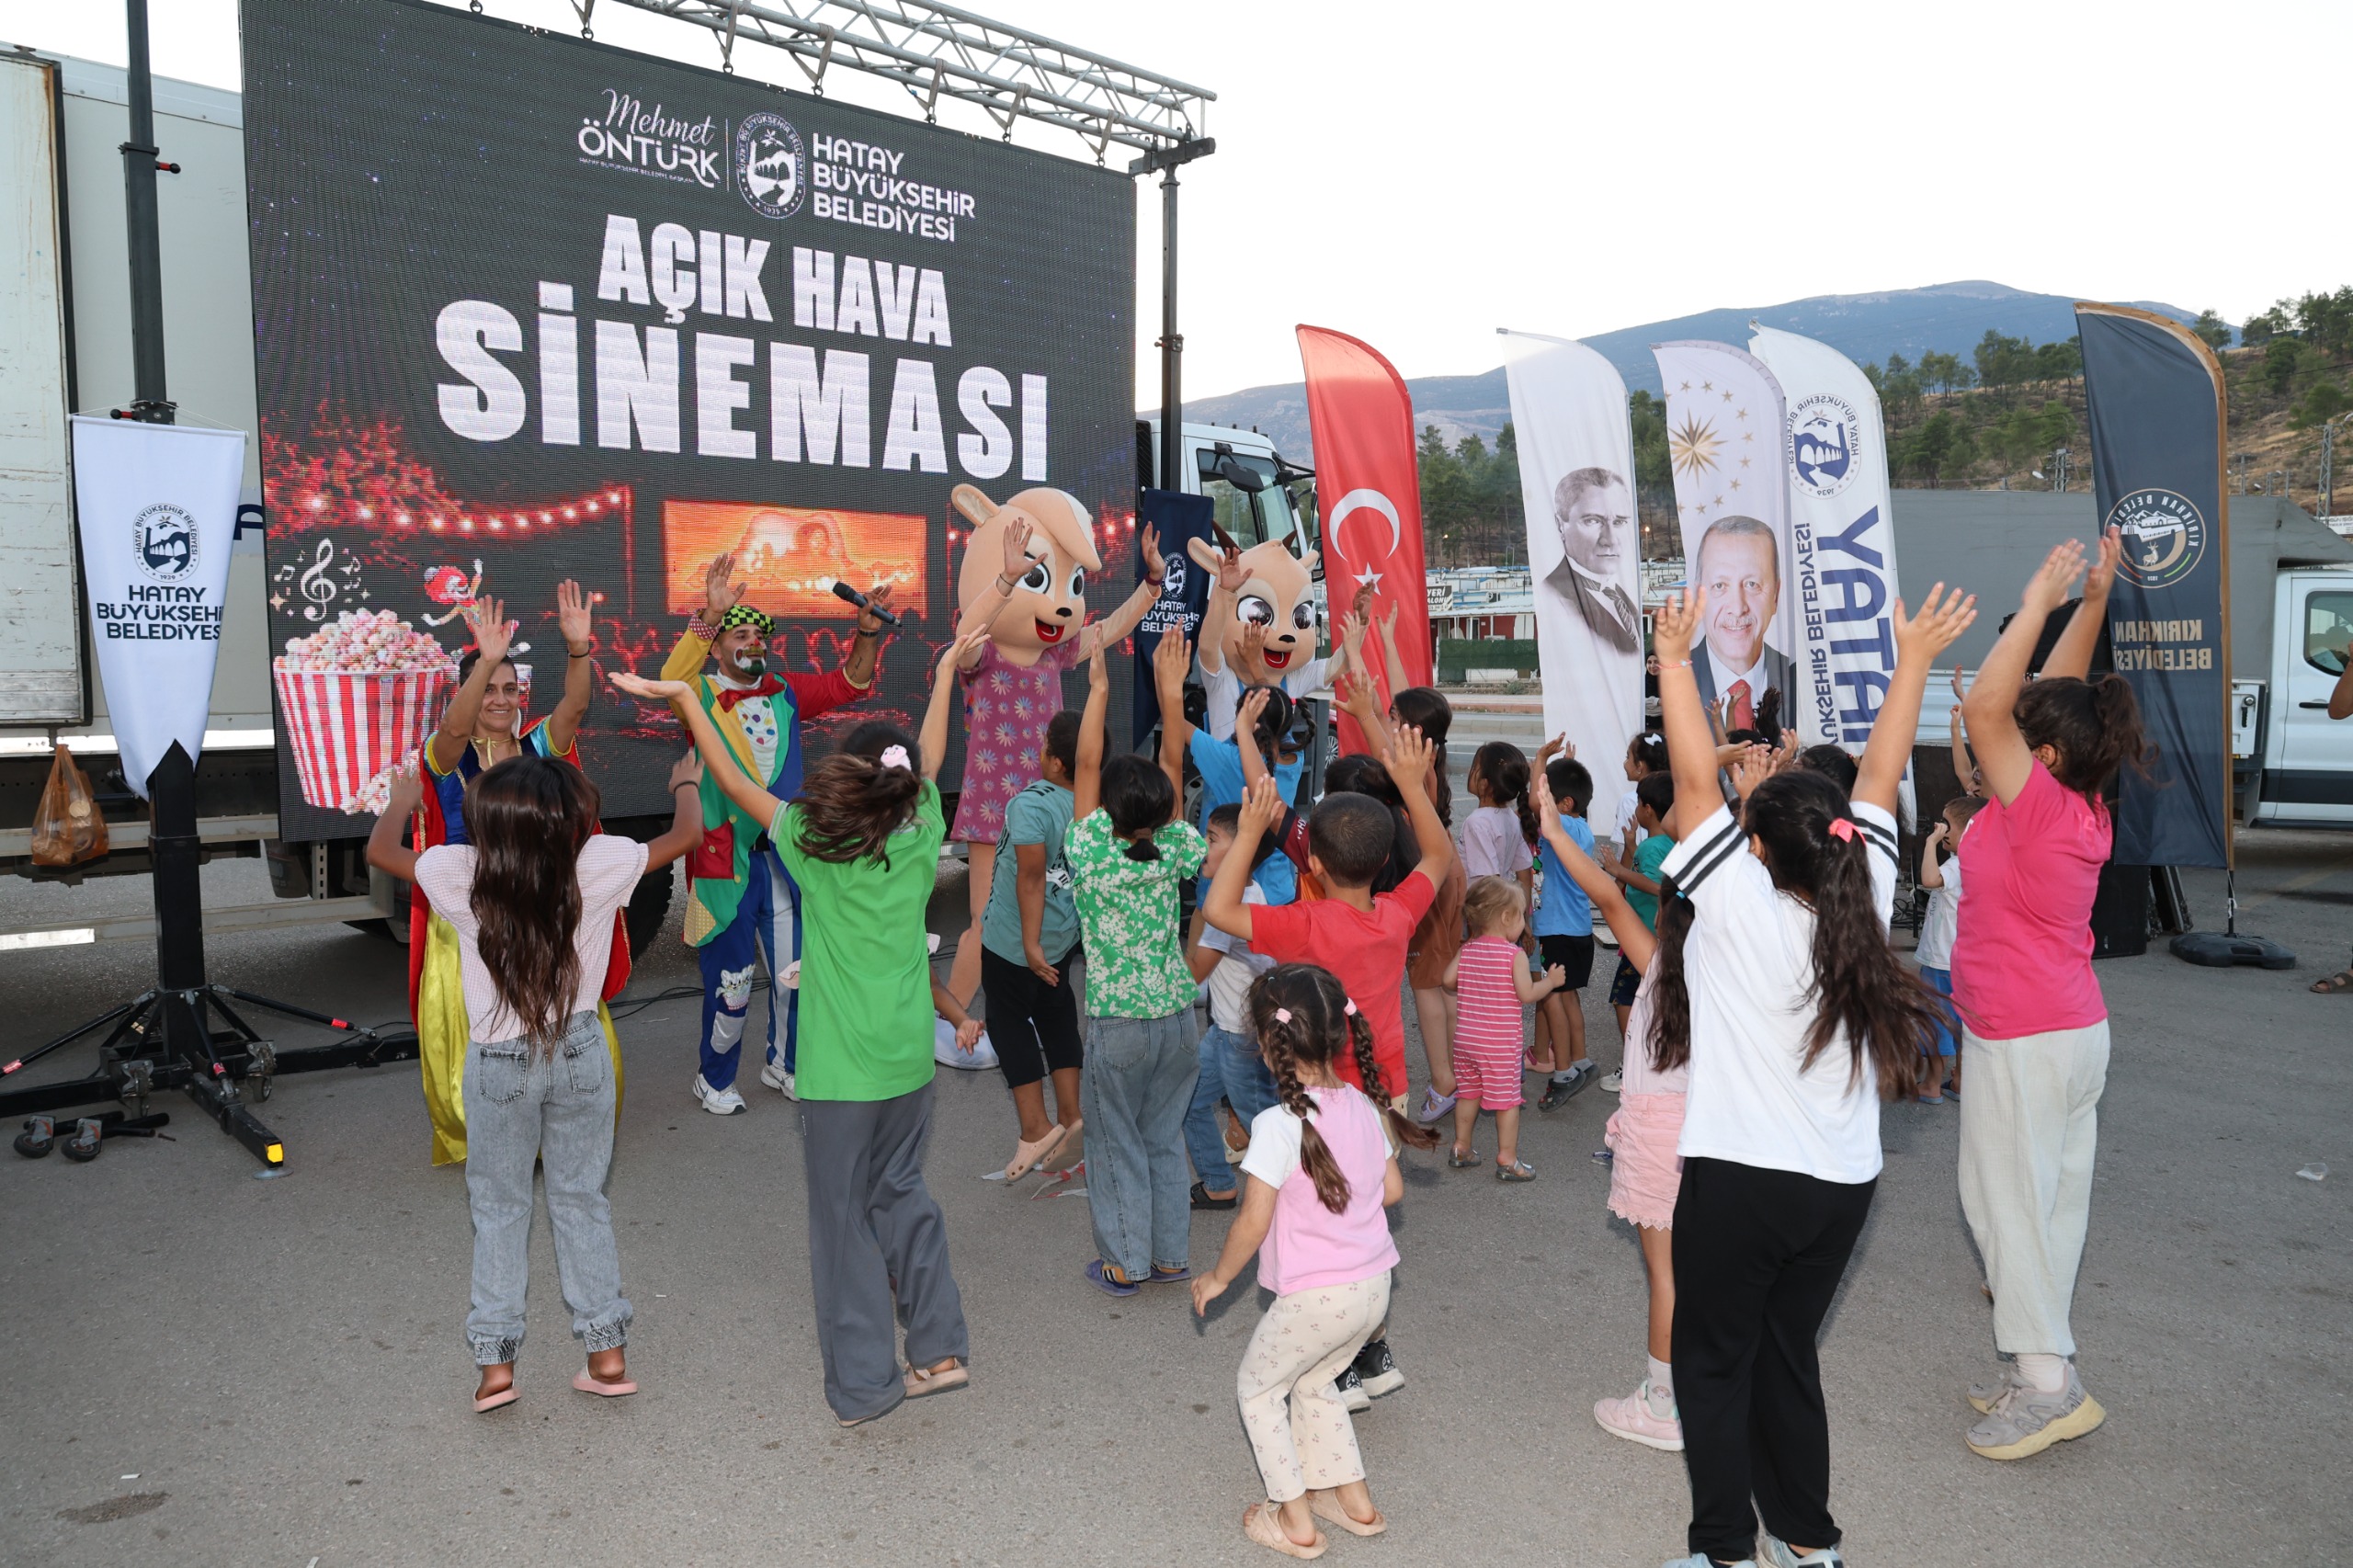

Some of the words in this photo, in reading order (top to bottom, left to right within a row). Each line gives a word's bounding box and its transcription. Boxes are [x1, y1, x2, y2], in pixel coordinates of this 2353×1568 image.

[602, 88, 718, 145] Mehmet
[578, 118, 722, 188] ÖNTÜRK
[813, 132, 904, 176] HATAY
[813, 191, 955, 242] BELEDİYESİ
[597, 213, 773, 324] AÇIK
[794, 245, 952, 347] HAVA
[436, 281, 1048, 483] SİNEMASI
[97, 602, 223, 622] BÜYÜKŞEHİ
[128, 585, 207, 603] HATAY
[1154, 599, 1187, 612] HATAY
[107, 622, 222, 641] BELEDİYES
